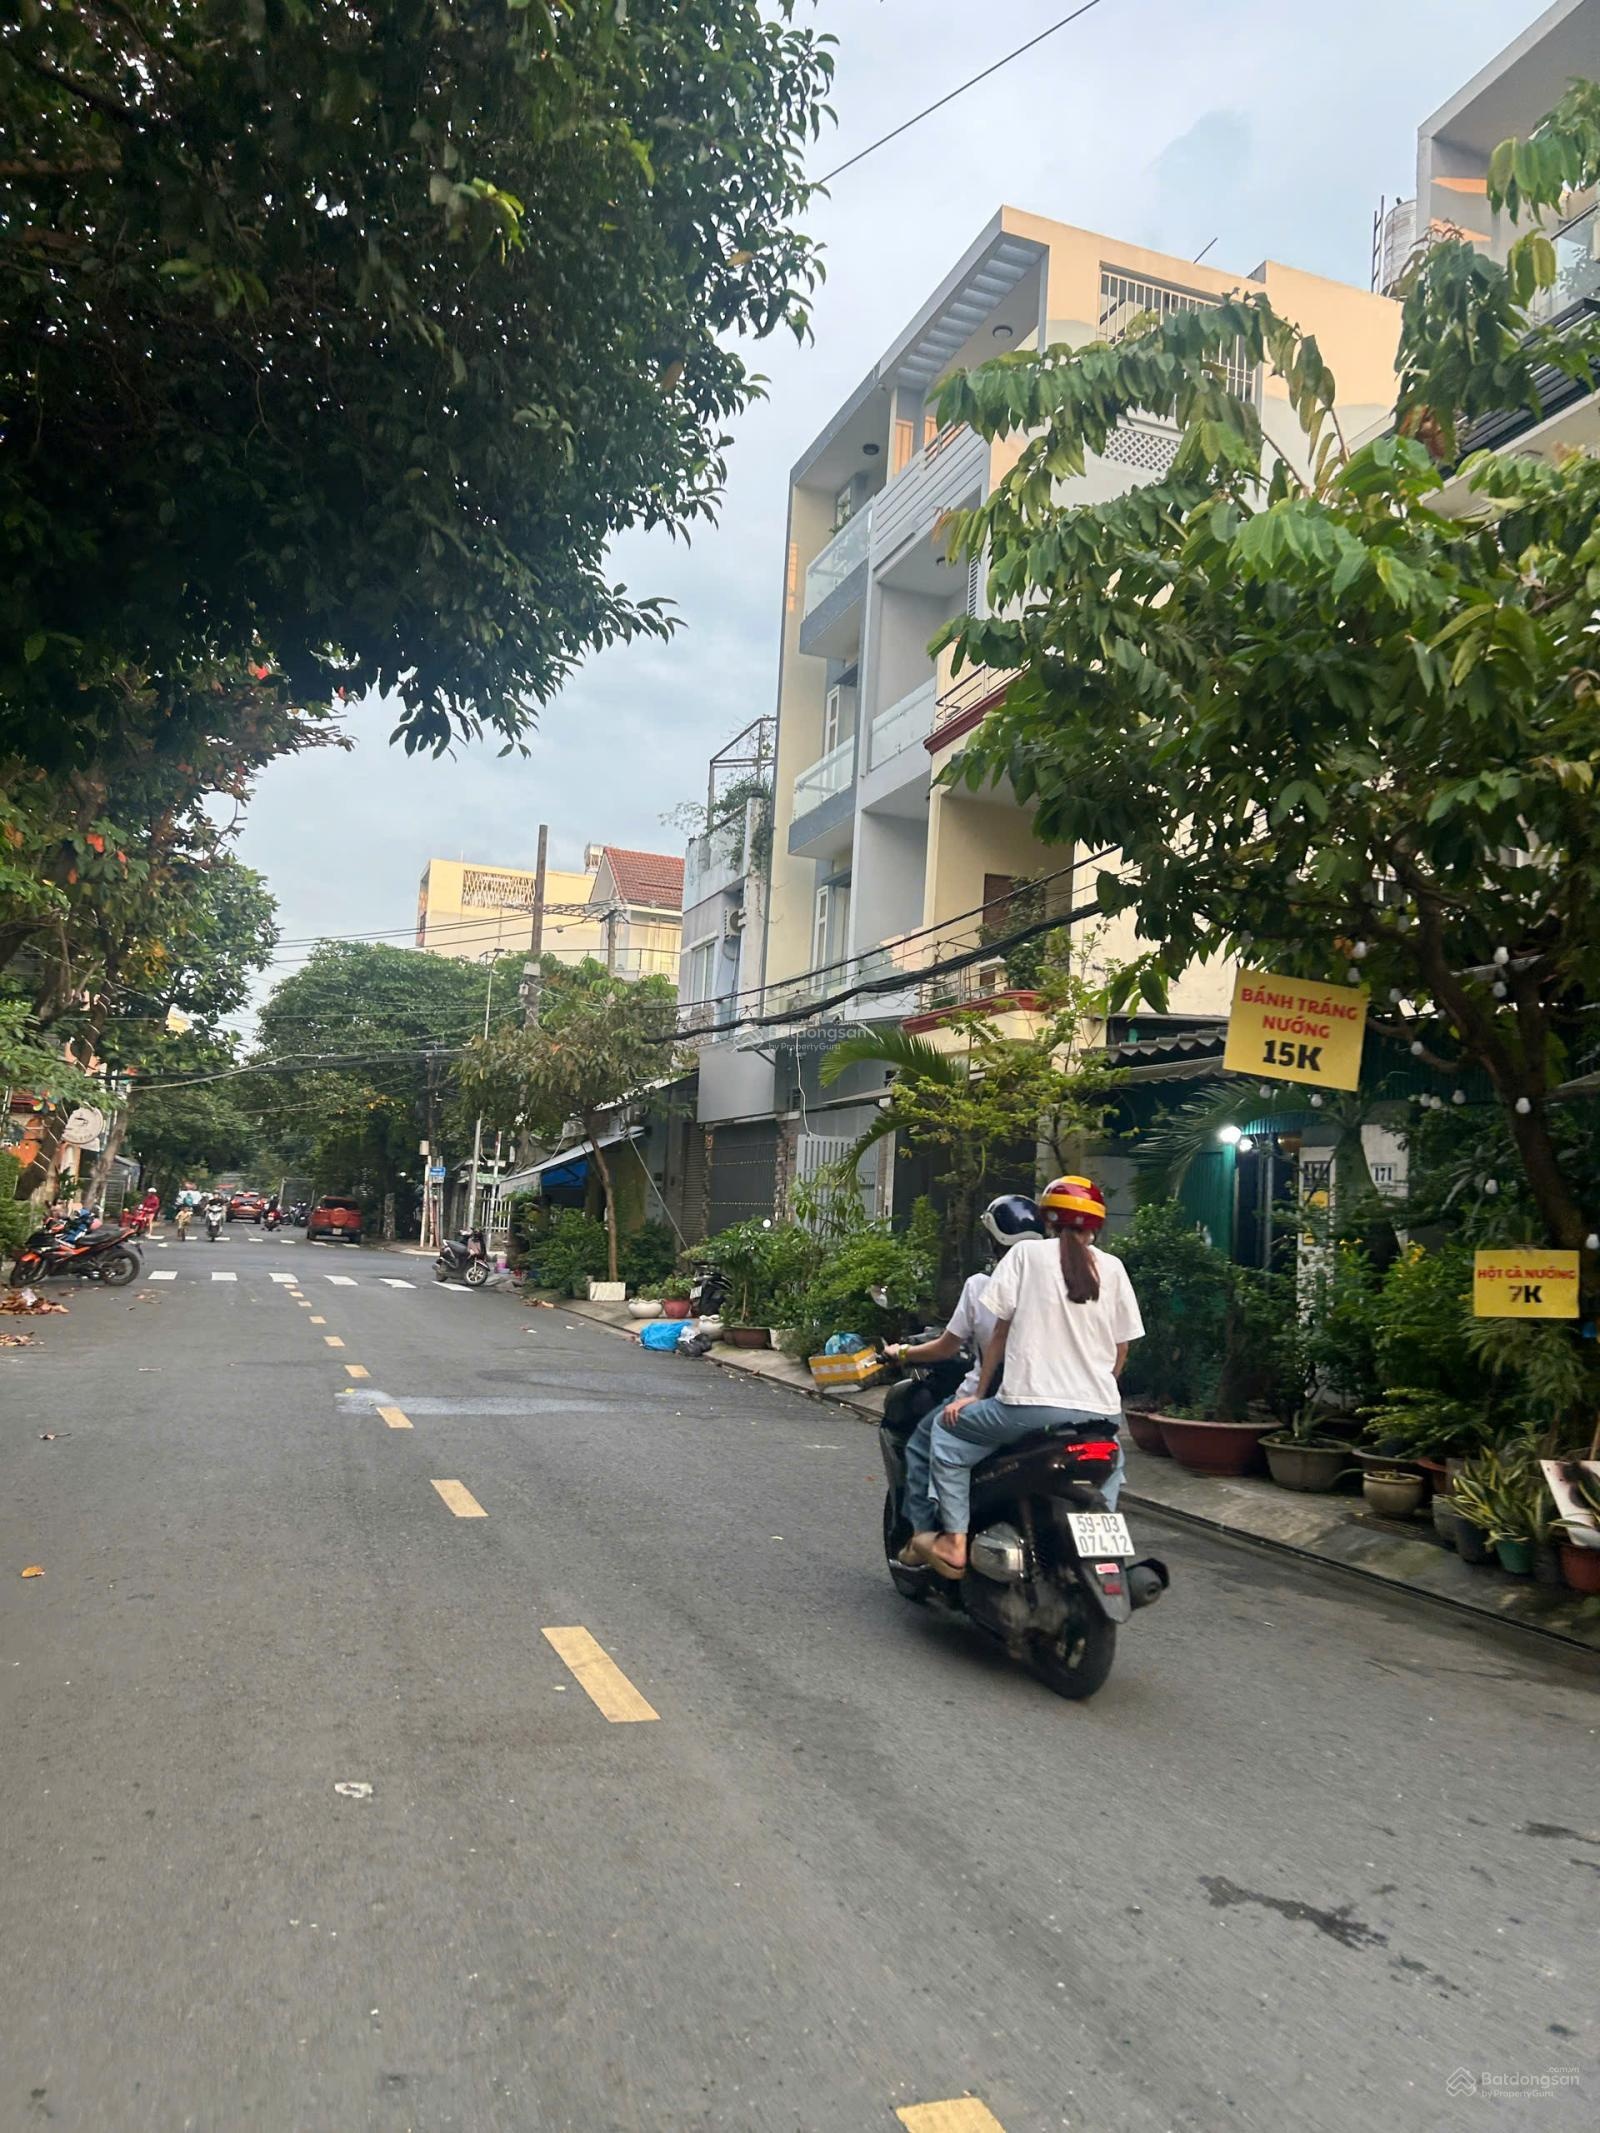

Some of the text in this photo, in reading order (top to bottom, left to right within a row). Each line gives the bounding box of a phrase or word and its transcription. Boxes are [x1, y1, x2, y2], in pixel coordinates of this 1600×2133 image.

[1240, 985, 1358, 1020] BÁNH TRÁNG
[1262, 1015, 1330, 1039] NƯỚNG
[1262, 1039, 1323, 1072] 15K
[1375, 1167, 1391, 1181] 171
[1478, 1265, 1503, 1281] HỘT
[1524, 1265, 1575, 1279] NƯỚNG
[1508, 1285, 1543, 1303] 7K
[1078, 1535, 1131, 1554] 074.12
